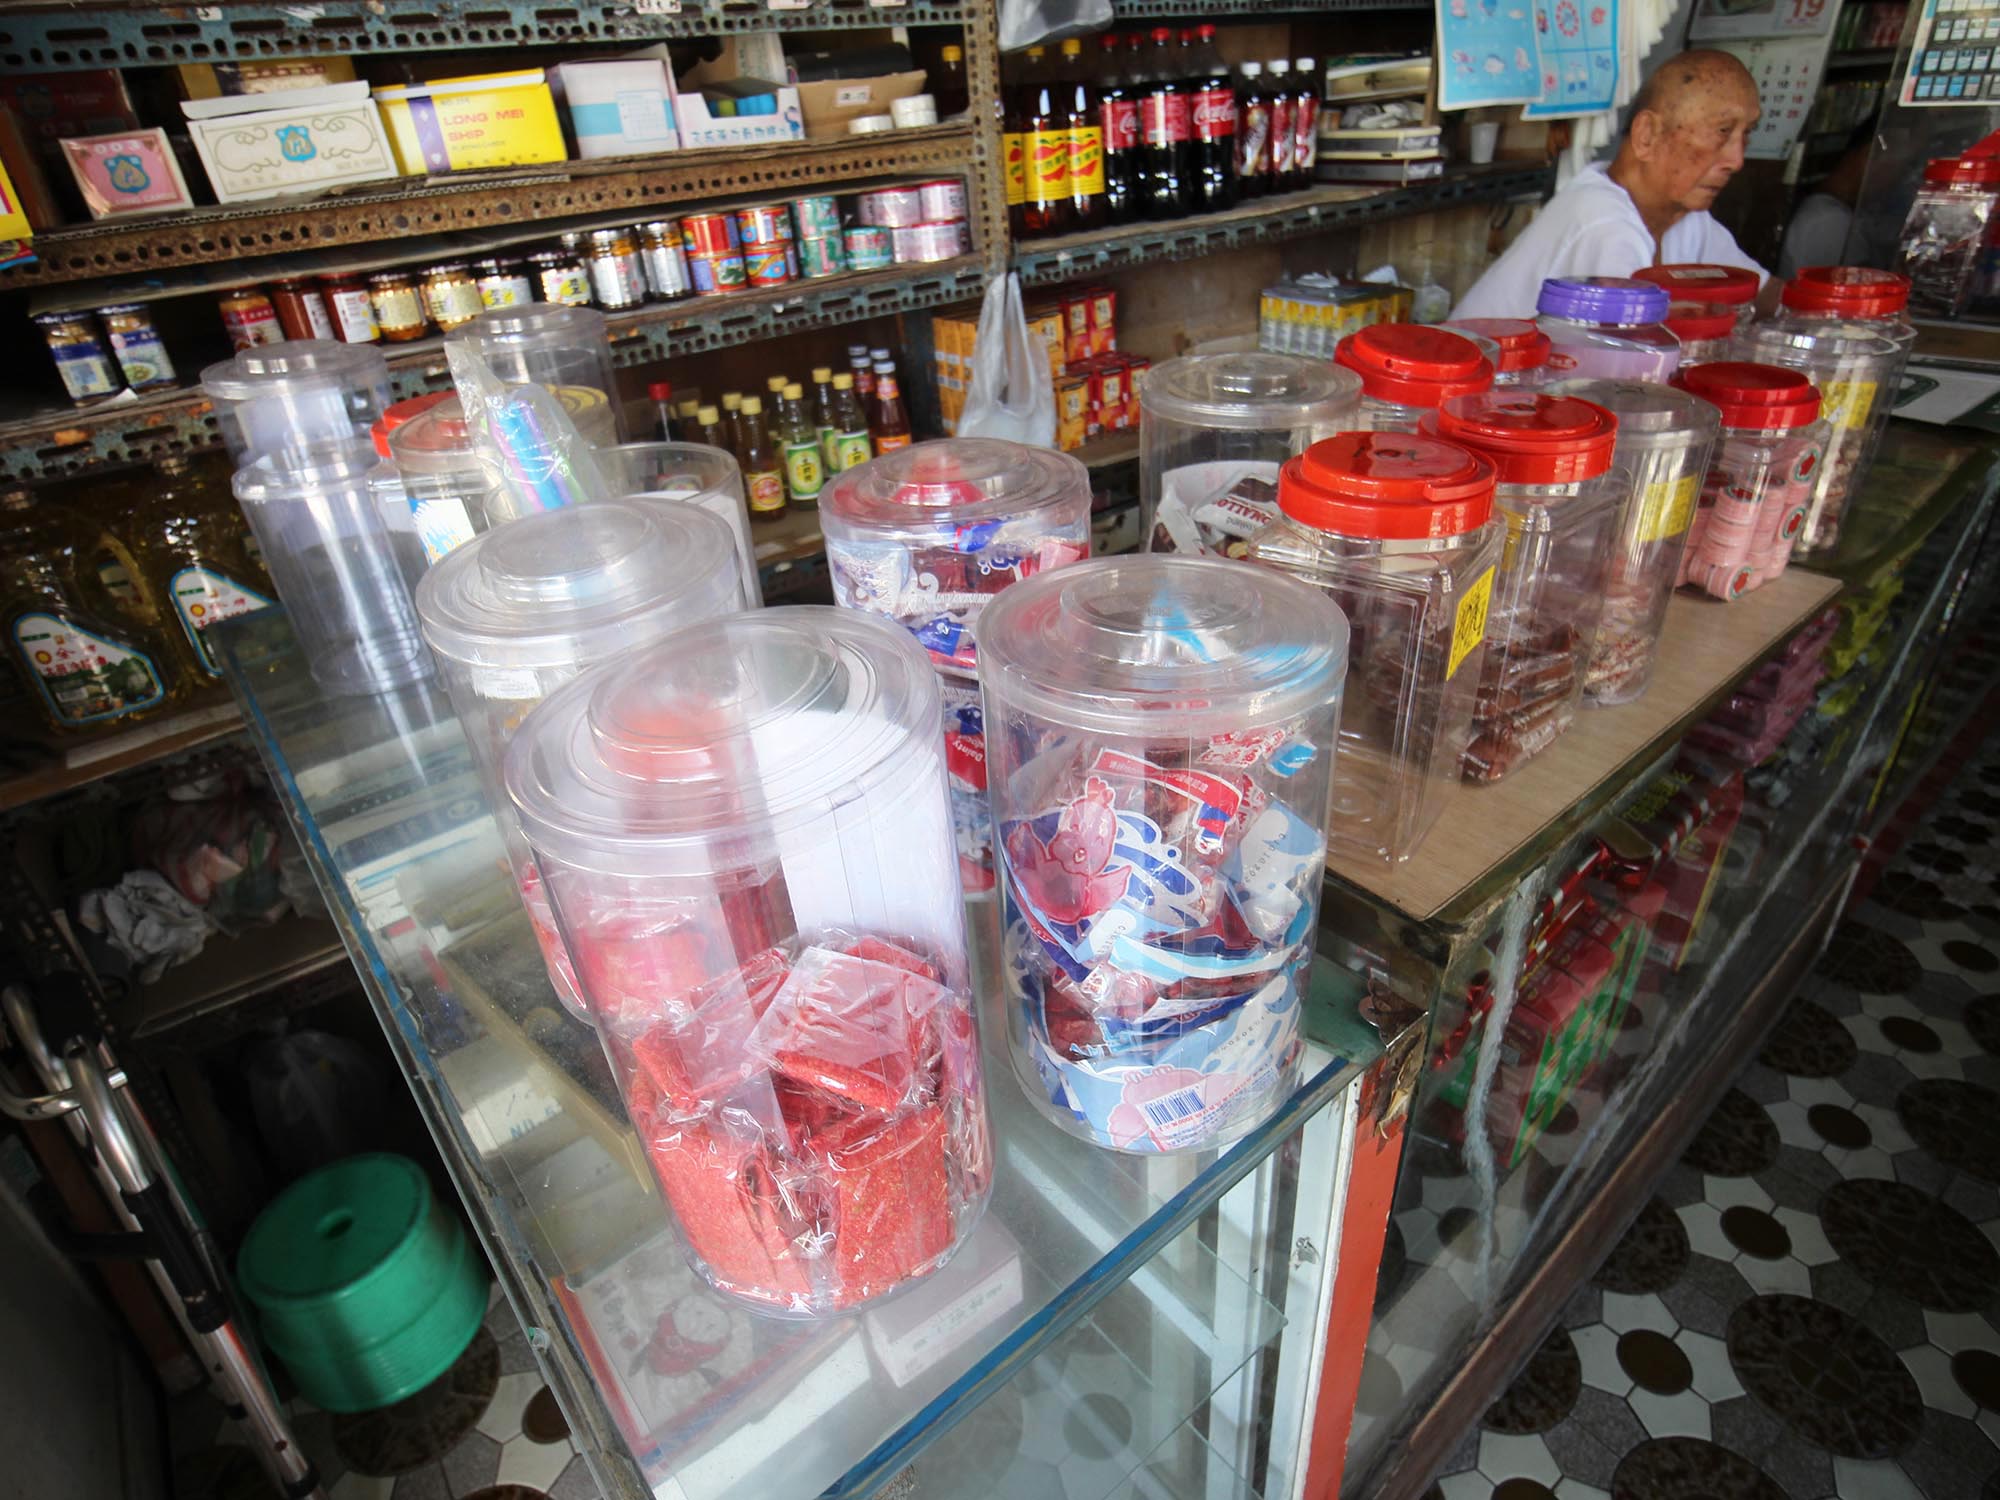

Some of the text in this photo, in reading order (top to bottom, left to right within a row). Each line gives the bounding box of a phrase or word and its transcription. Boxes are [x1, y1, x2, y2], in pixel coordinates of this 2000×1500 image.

[443, 108, 525, 126] LONG MEI
[448, 129, 485, 142] SHIP
[952, 740, 984, 762] Dainty
